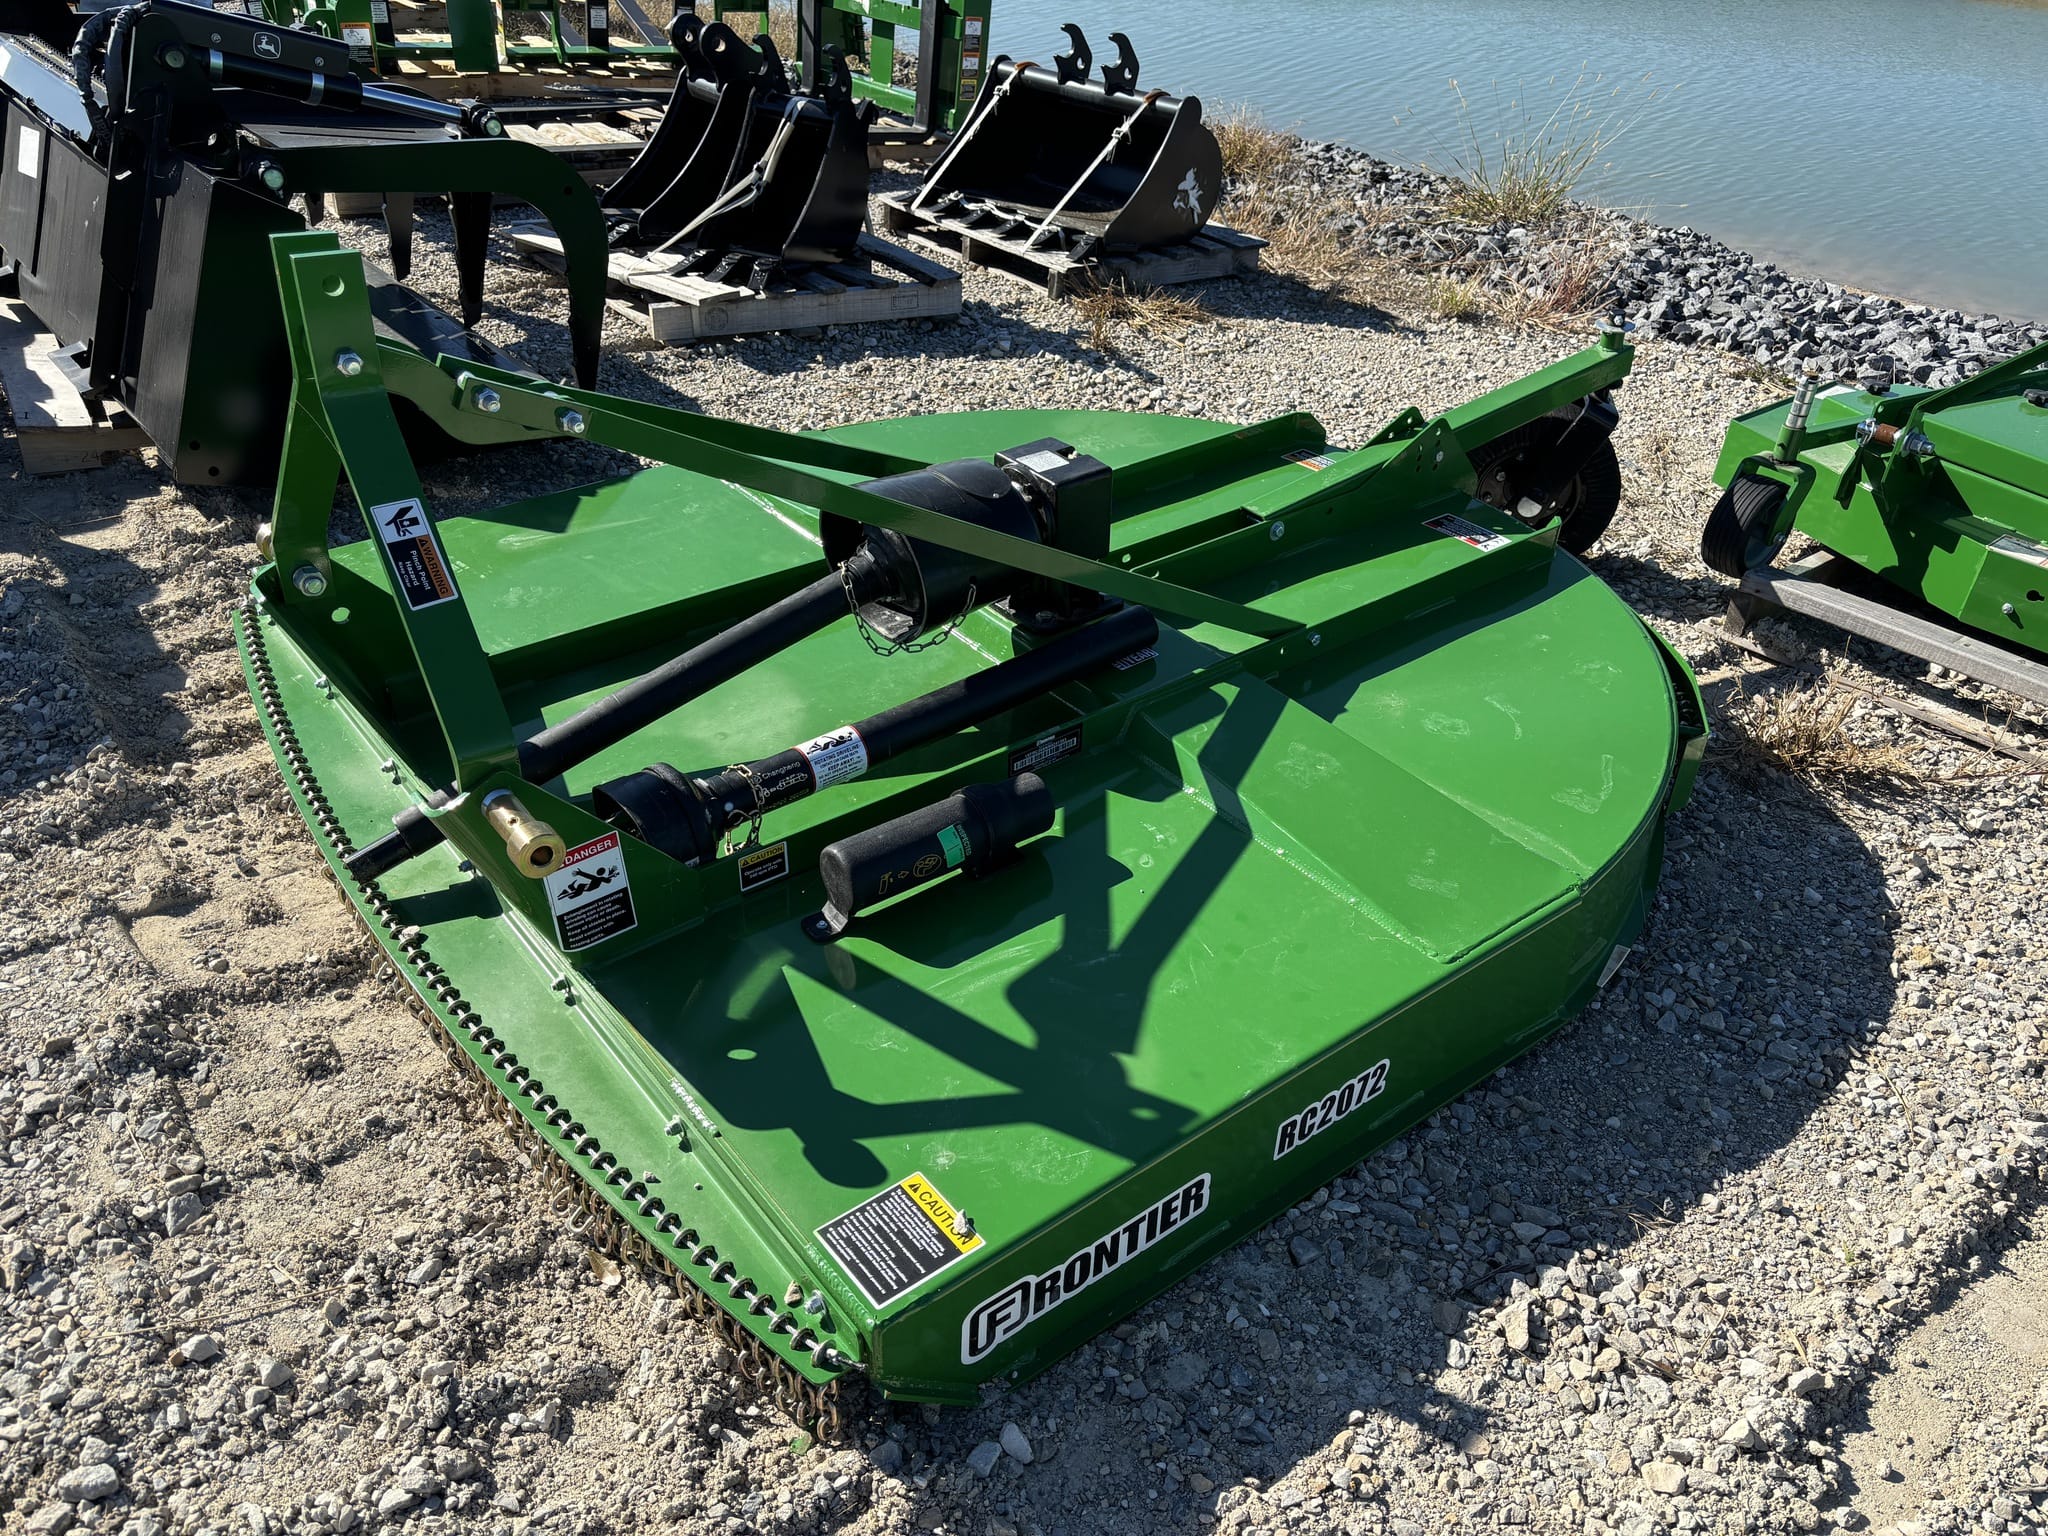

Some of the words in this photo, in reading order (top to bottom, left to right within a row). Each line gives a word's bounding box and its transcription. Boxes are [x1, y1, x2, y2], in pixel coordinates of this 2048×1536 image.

[405, 561, 420, 586] Hazard
[410, 550, 422, 574] Pinch
[419, 571, 431, 590] Point
[423, 545, 448, 595] WARNING
[565, 839, 612, 865] DANGER
[751, 846, 782, 861] CAUTION
[1275, 1062, 1387, 1157] RC2072
[900, 1194, 913, 1206] Avoid
[910, 1205, 927, 1221] Serious
[923, 1221, 939, 1235] Injury:
[968, 1176, 1207, 1359] FRONTIER
